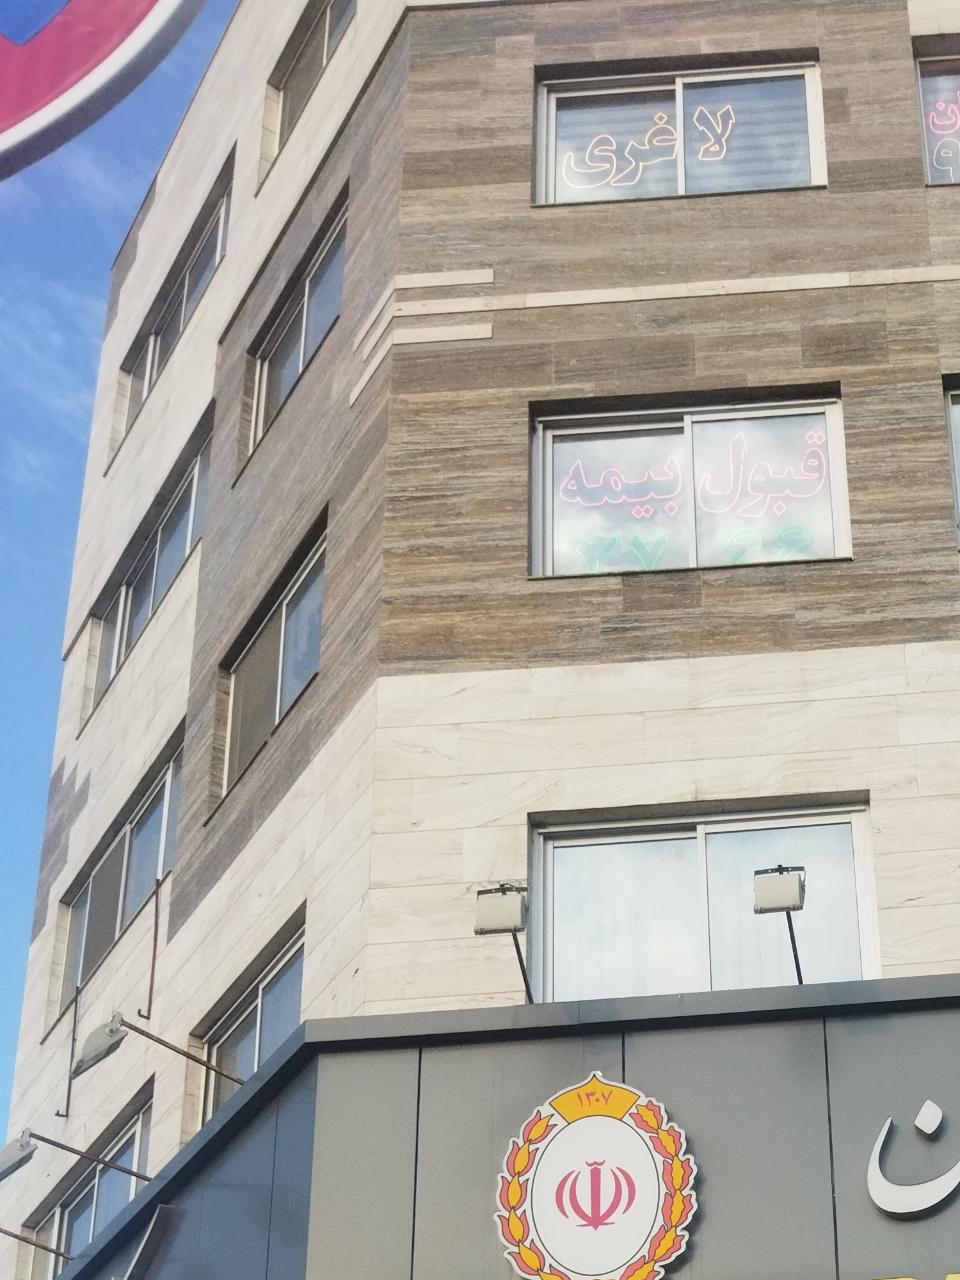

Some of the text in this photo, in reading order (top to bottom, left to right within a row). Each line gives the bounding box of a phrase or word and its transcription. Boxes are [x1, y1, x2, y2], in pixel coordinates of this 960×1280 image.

[563, 105, 735, 188] لاغری
[560, 431, 828, 518] قبول بیمه
[576, 1089, 613, 1108] ۱۳۰۷
